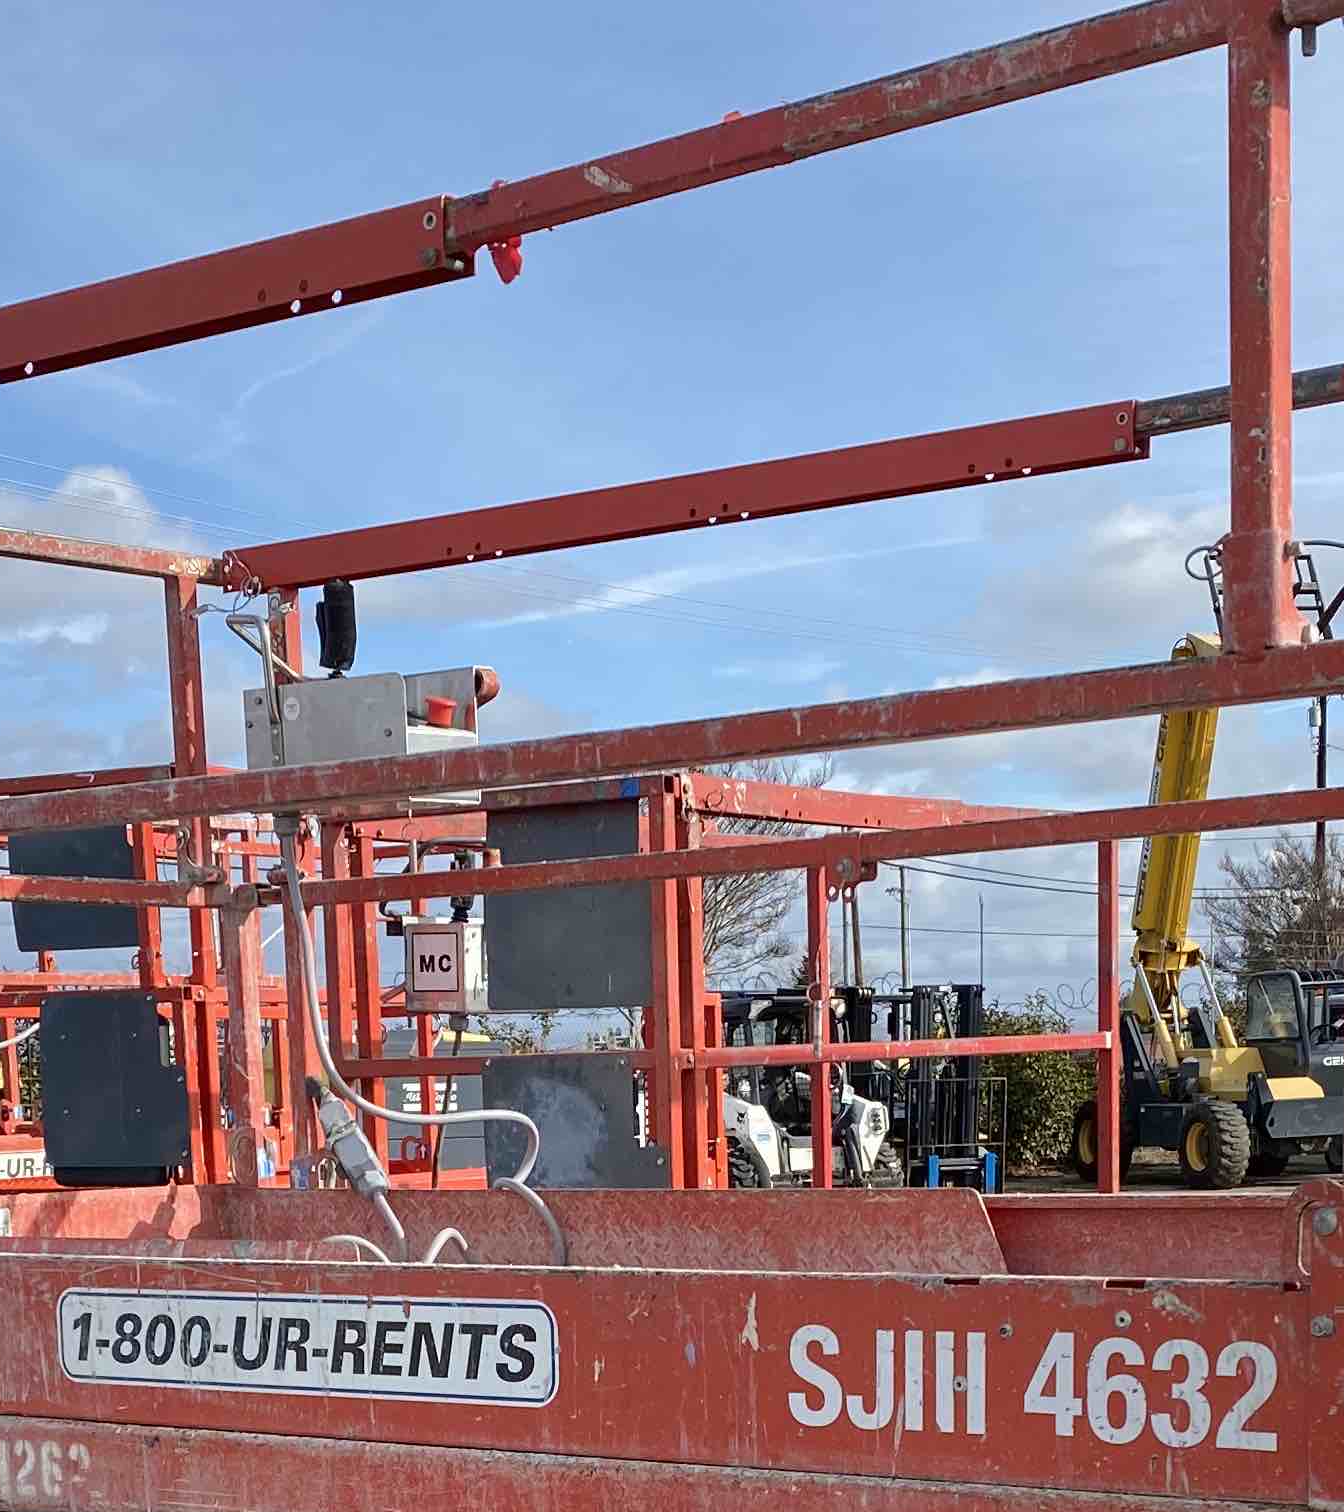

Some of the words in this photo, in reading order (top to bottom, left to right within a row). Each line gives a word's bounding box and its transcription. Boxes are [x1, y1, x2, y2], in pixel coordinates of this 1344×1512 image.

[419, 954, 452, 972] MC
[1323, 1056, 1344, 1066] GE
[72, 1312, 537, 1383] 1-800-UR-RENTS
[788, 1324, 986, 1435] SJIII
[1024, 1331, 1278, 1452] 4632
